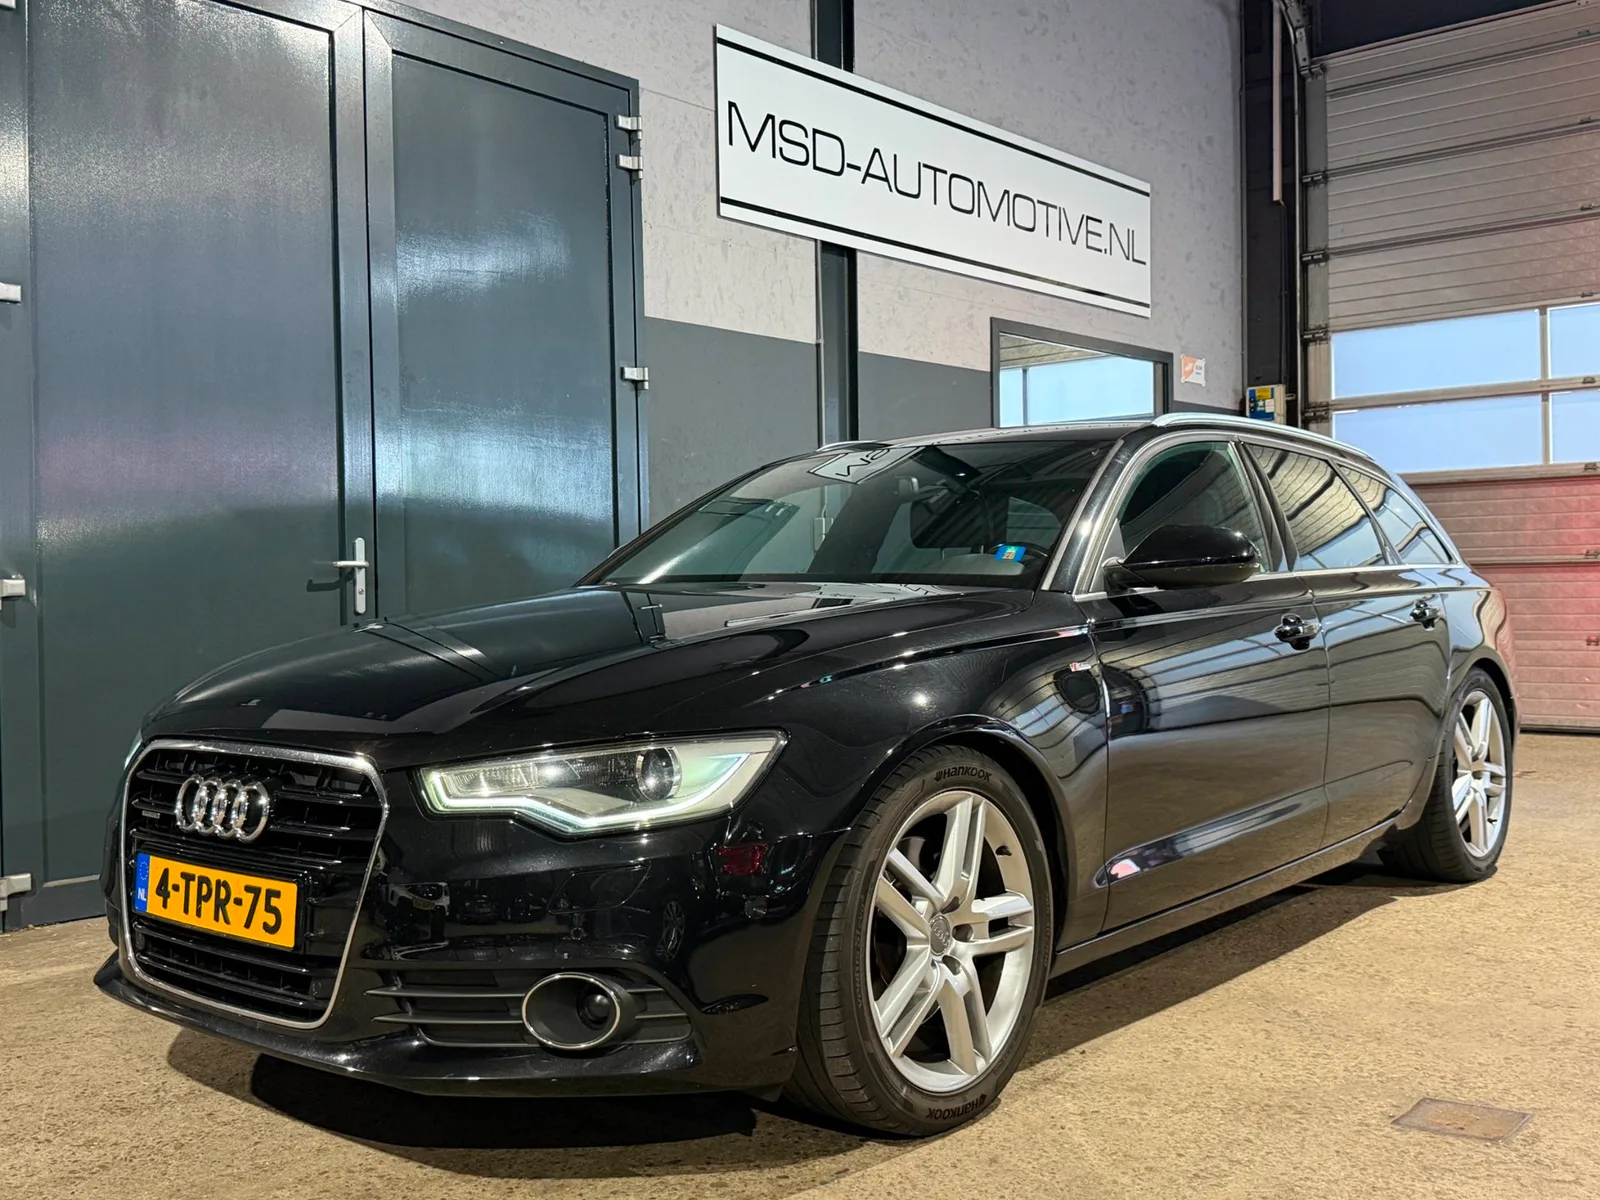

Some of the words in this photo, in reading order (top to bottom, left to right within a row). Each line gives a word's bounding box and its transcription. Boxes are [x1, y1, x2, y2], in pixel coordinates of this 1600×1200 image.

[727, 100, 1147, 266] MSD-AUTOMOTIVE.NL
[138, 887, 147, 901] NL
[155, 867, 282, 935] 4-TPR-75
